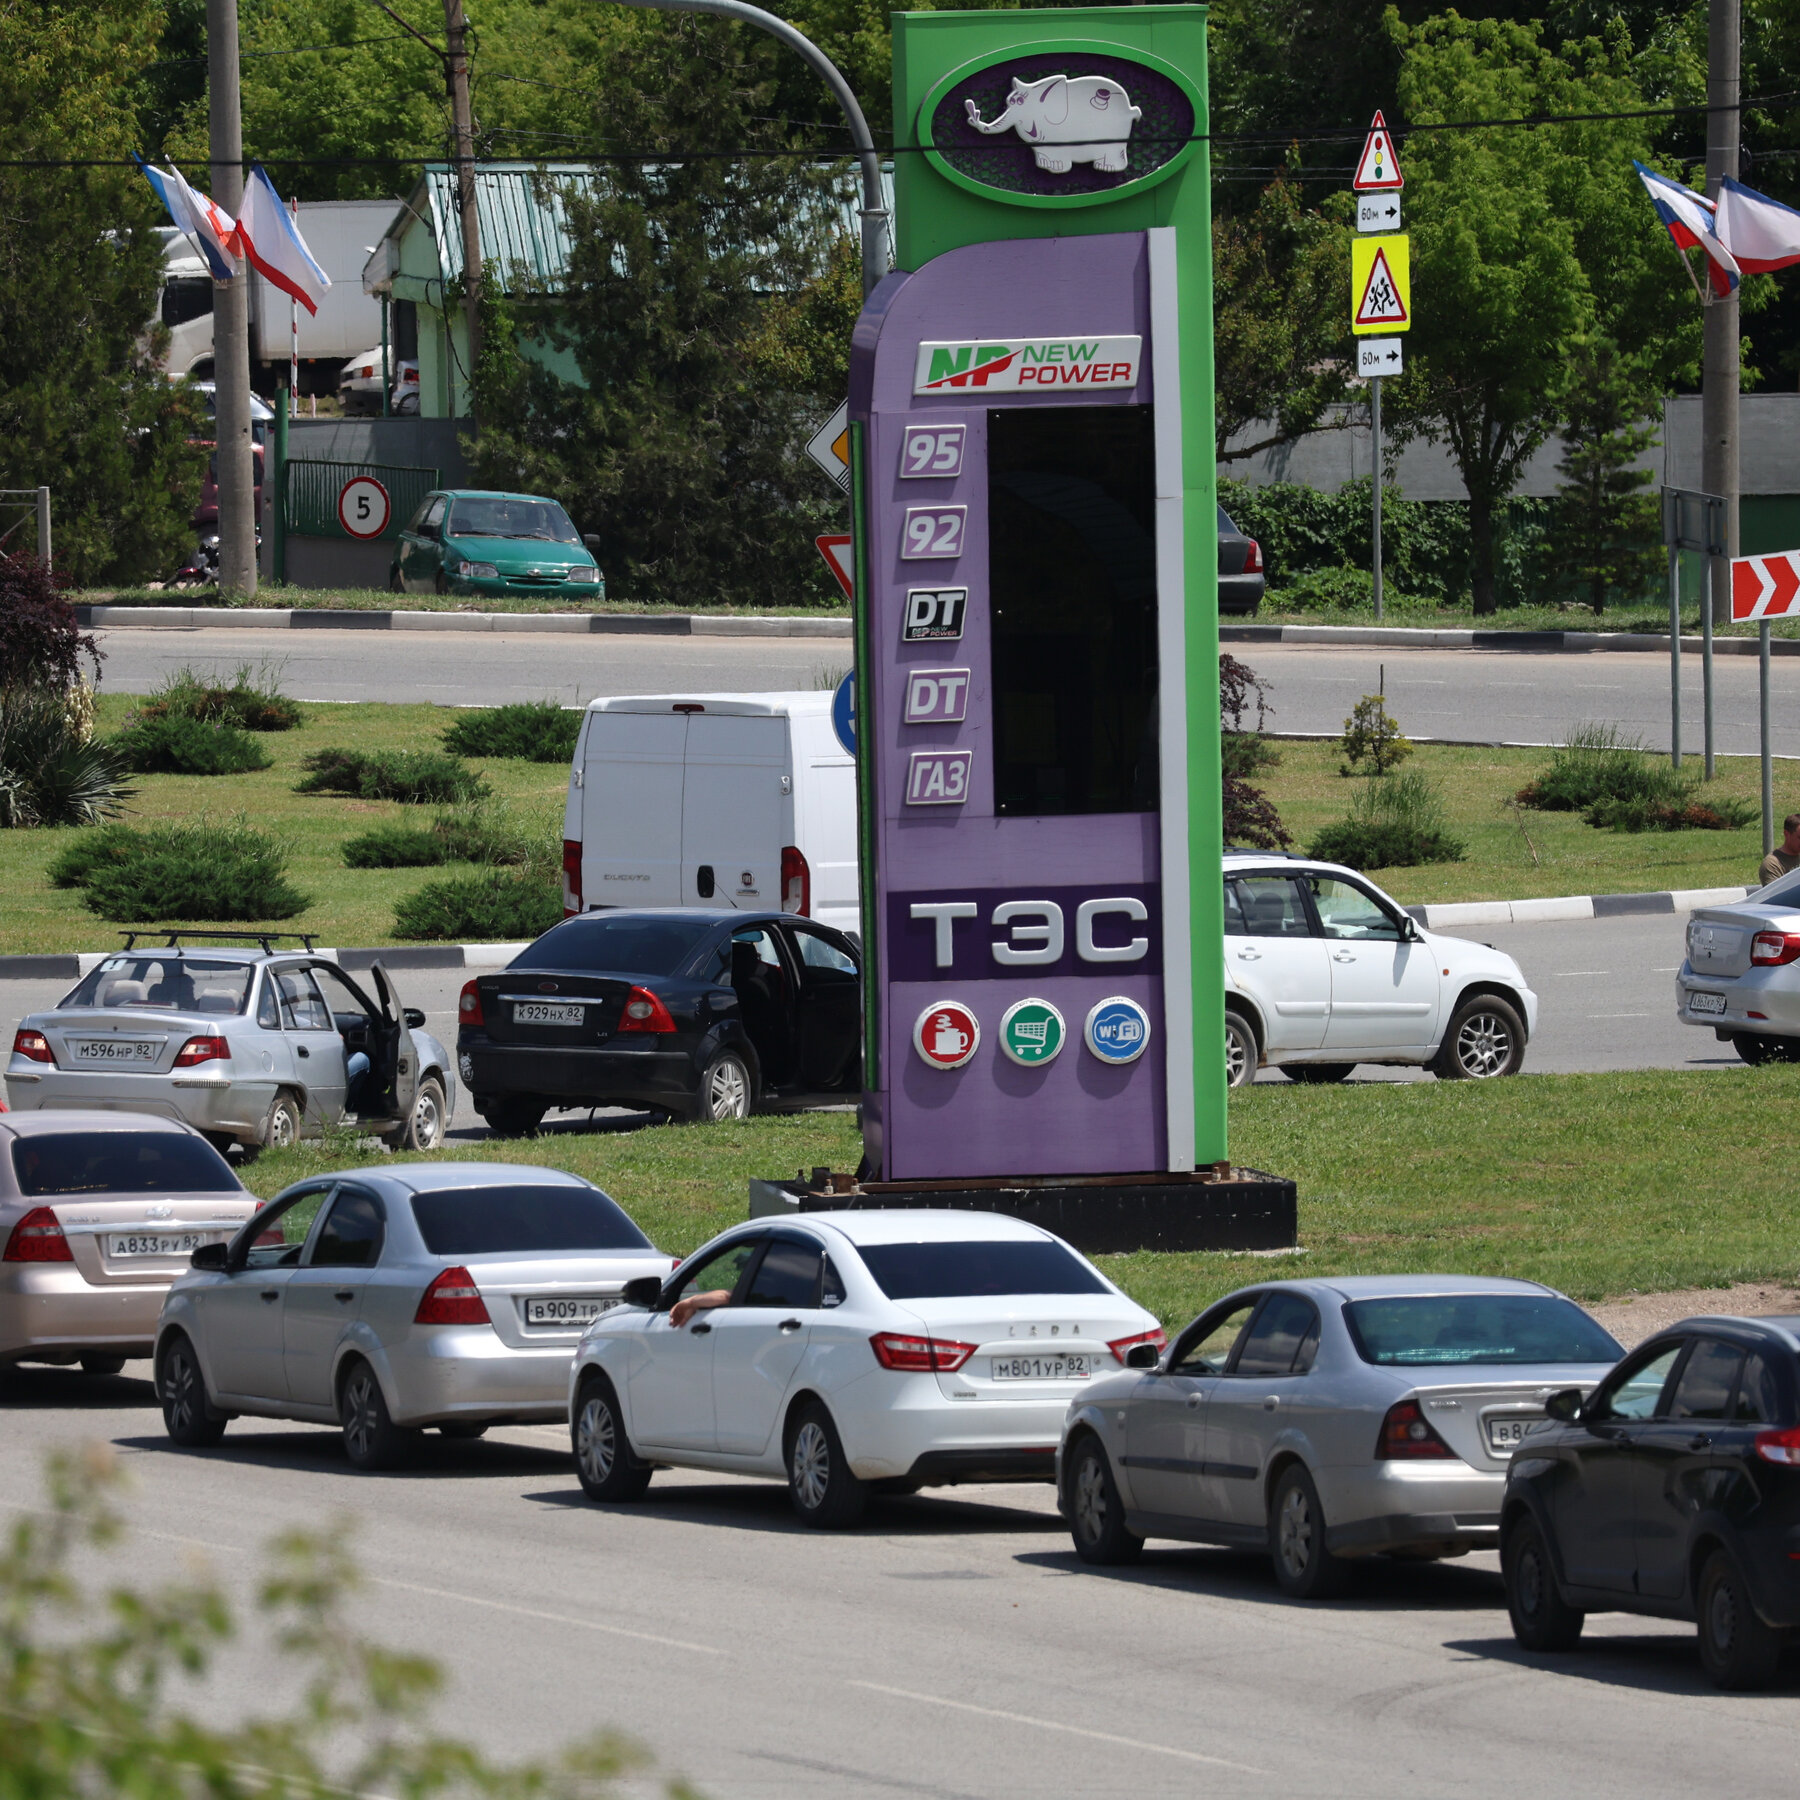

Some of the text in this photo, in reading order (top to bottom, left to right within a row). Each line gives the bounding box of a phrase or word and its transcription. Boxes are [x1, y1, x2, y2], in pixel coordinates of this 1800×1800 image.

[921, 346, 1018, 388] NP
[1022, 343, 1099, 363] NEW
[1018, 362, 1132, 385] POWER
[908, 433, 961, 472] 95
[357, 495, 371, 520] 5
[909, 514, 961, 553] 92
[908, 592, 965, 627] DT
[910, 677, 966, 716] DT
[912, 760, 966, 798] ГАЗ
[910, 897, 1149, 967] ТЭС
[136, 1044, 150, 1055] 82
[1068, 1357, 1084, 1371] 82
